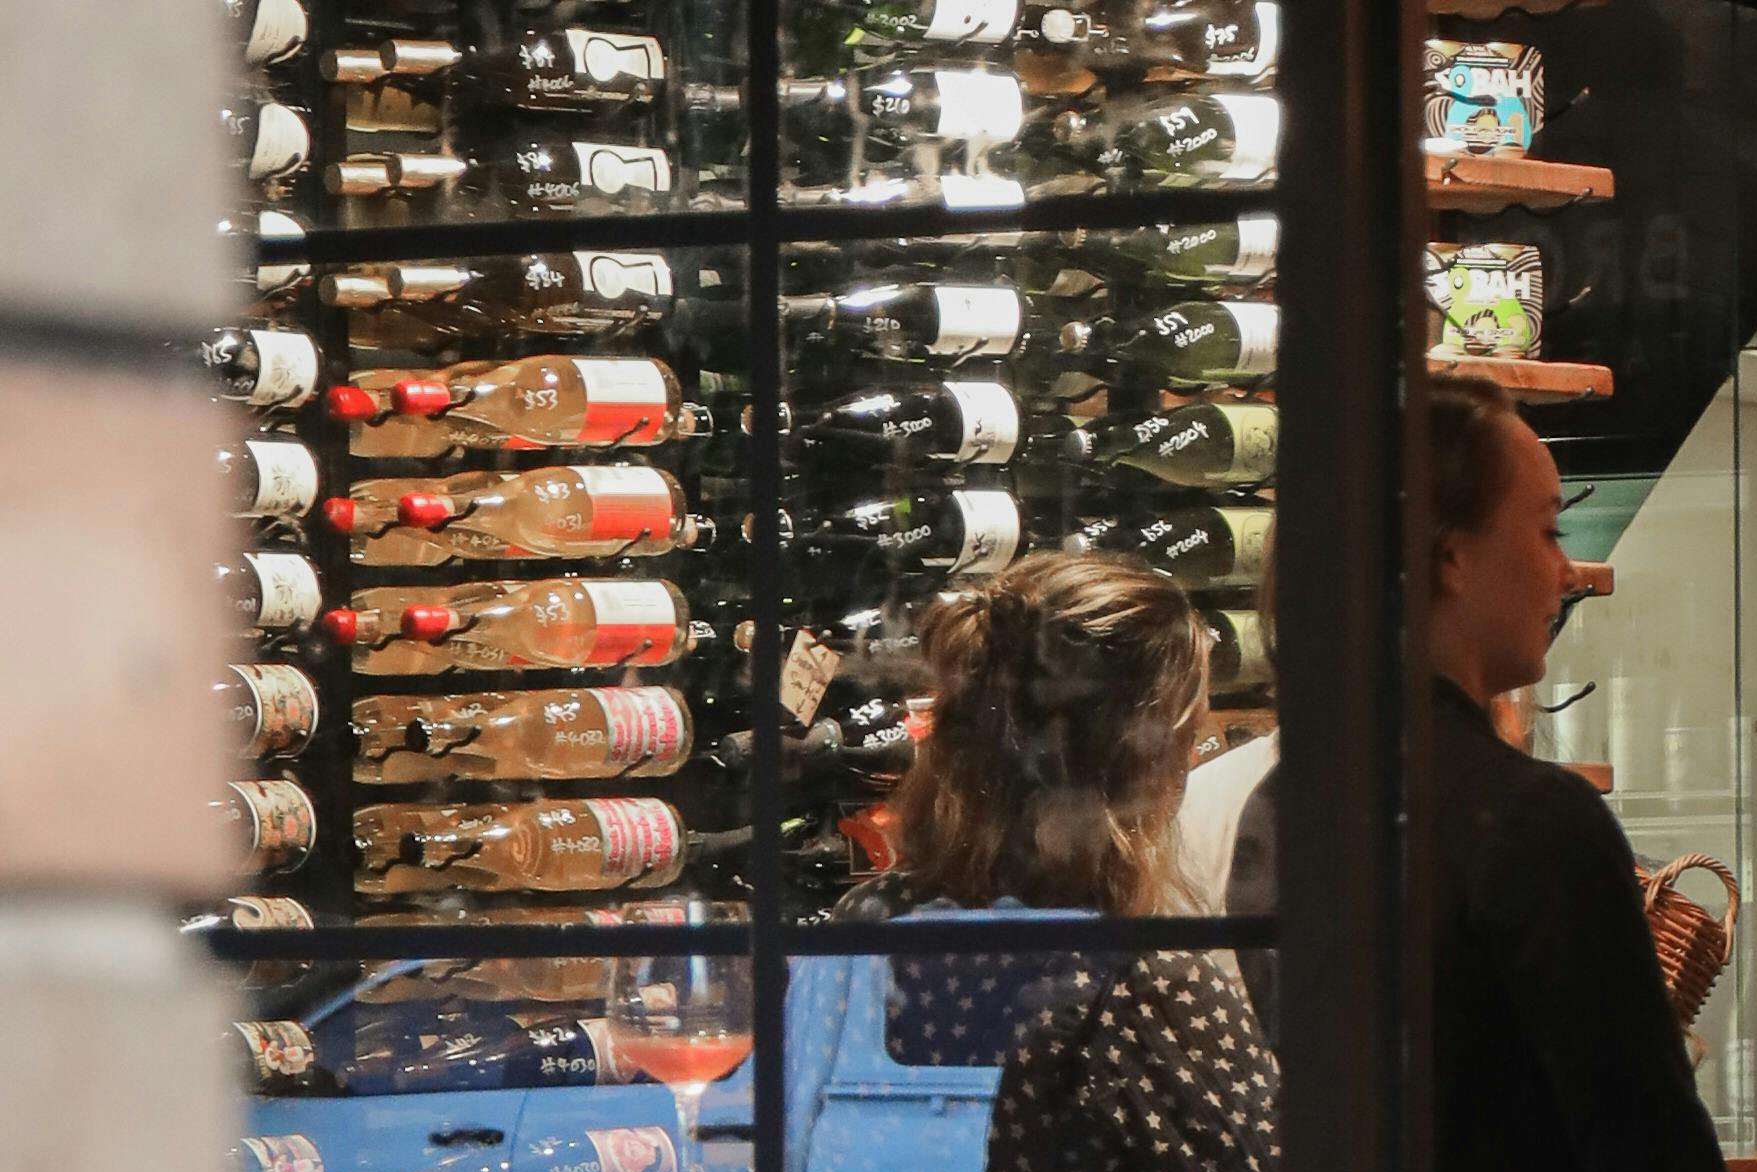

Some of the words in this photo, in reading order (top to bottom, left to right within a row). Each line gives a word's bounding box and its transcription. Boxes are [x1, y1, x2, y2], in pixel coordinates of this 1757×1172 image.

[1166, 128, 1218, 158] #2000
[1166, 229, 1217, 256] #2000
[1158, 420, 1210, 458] #2004
[877, 524, 934, 550] #3000
[1166, 528, 1211, 561] #2004
